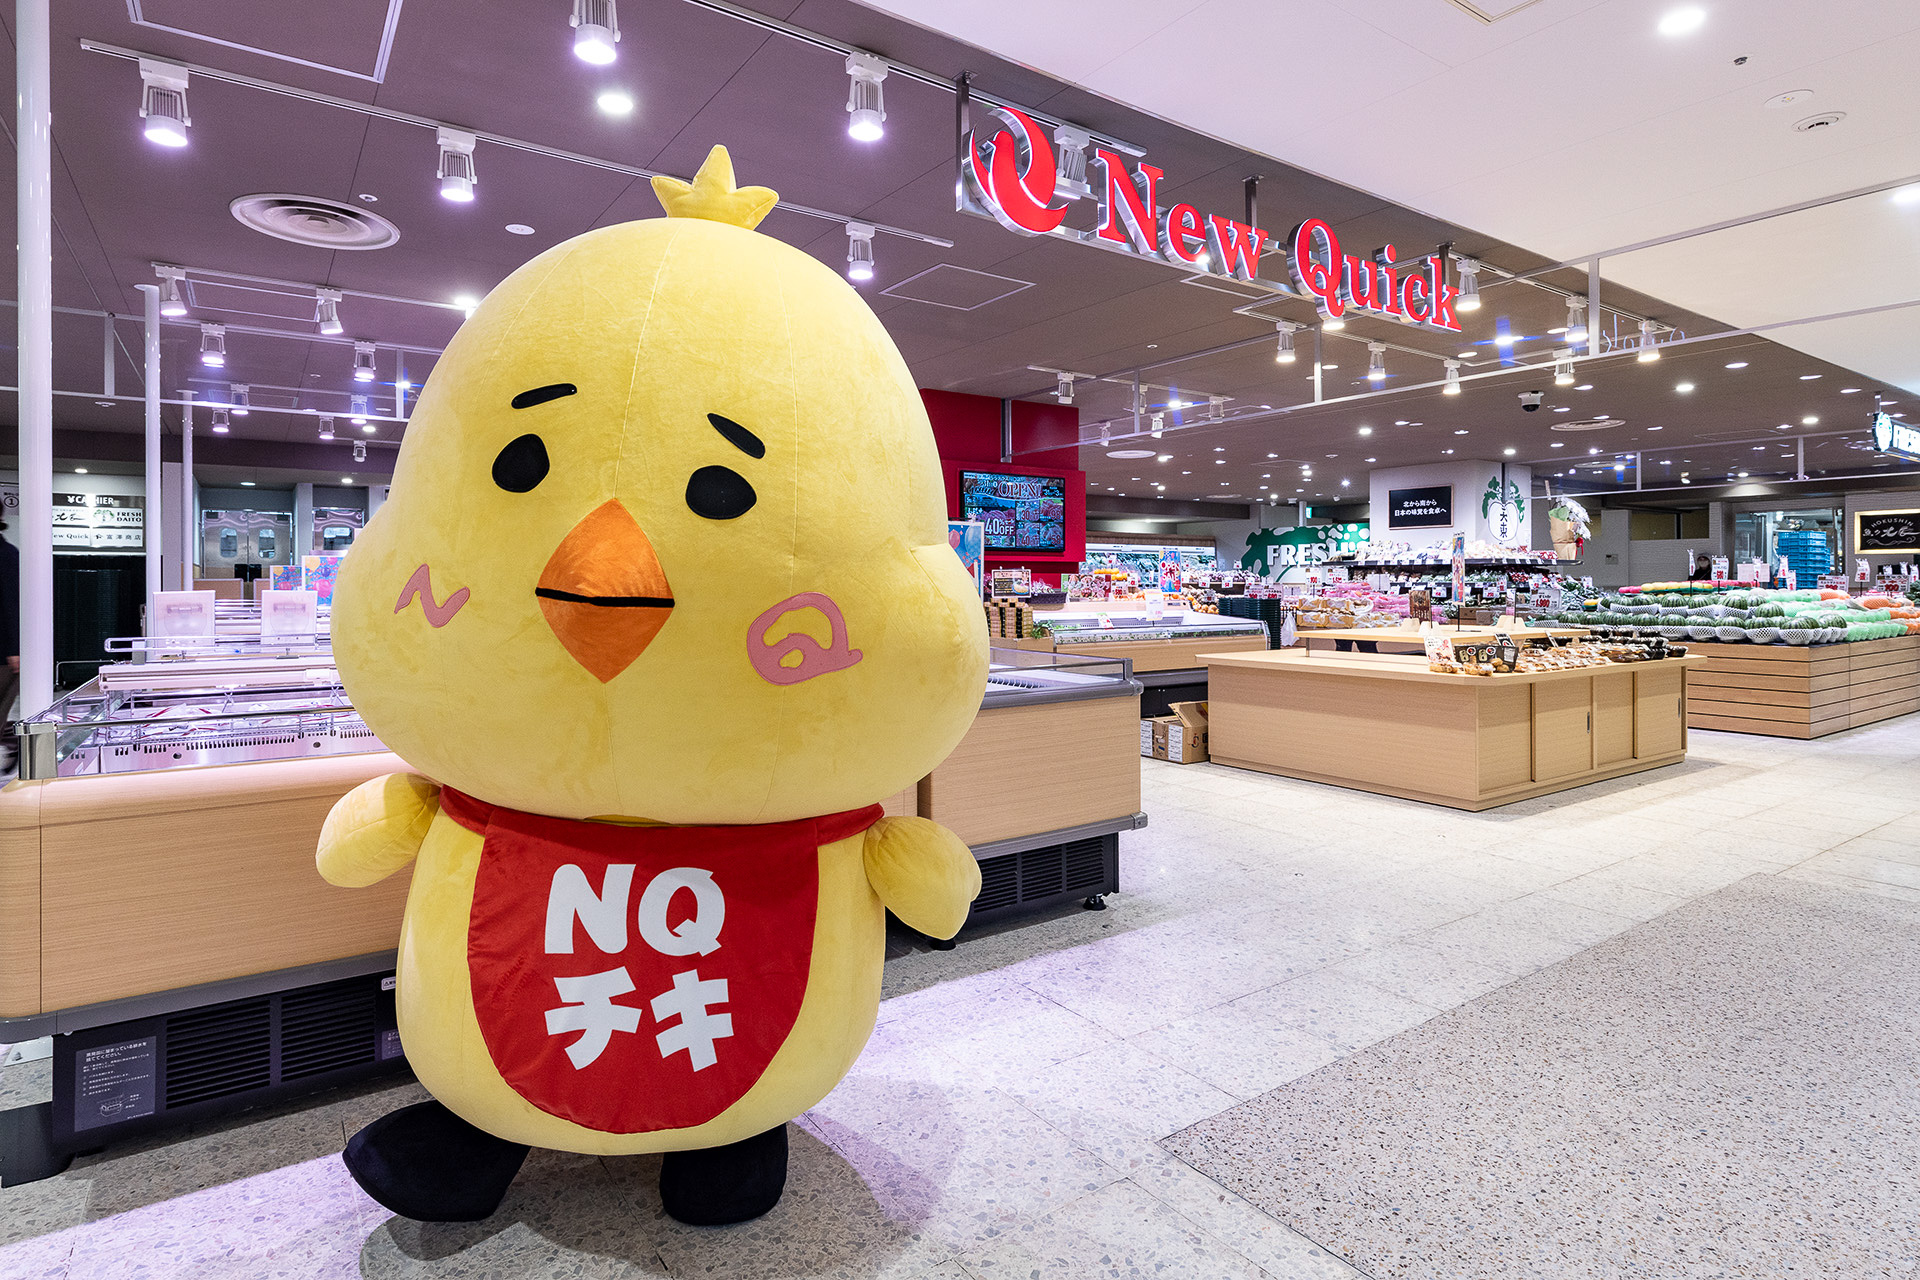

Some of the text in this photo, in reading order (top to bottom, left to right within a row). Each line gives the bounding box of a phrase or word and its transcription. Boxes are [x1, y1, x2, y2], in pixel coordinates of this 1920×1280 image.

[1094, 147, 1463, 332] New Quick
[75, 496, 114, 505] CAHIER
[1871, 518, 1914, 528] HOKUSHIN
[544, 863, 726, 958] NQ
[544, 965, 735, 1073] チキ
